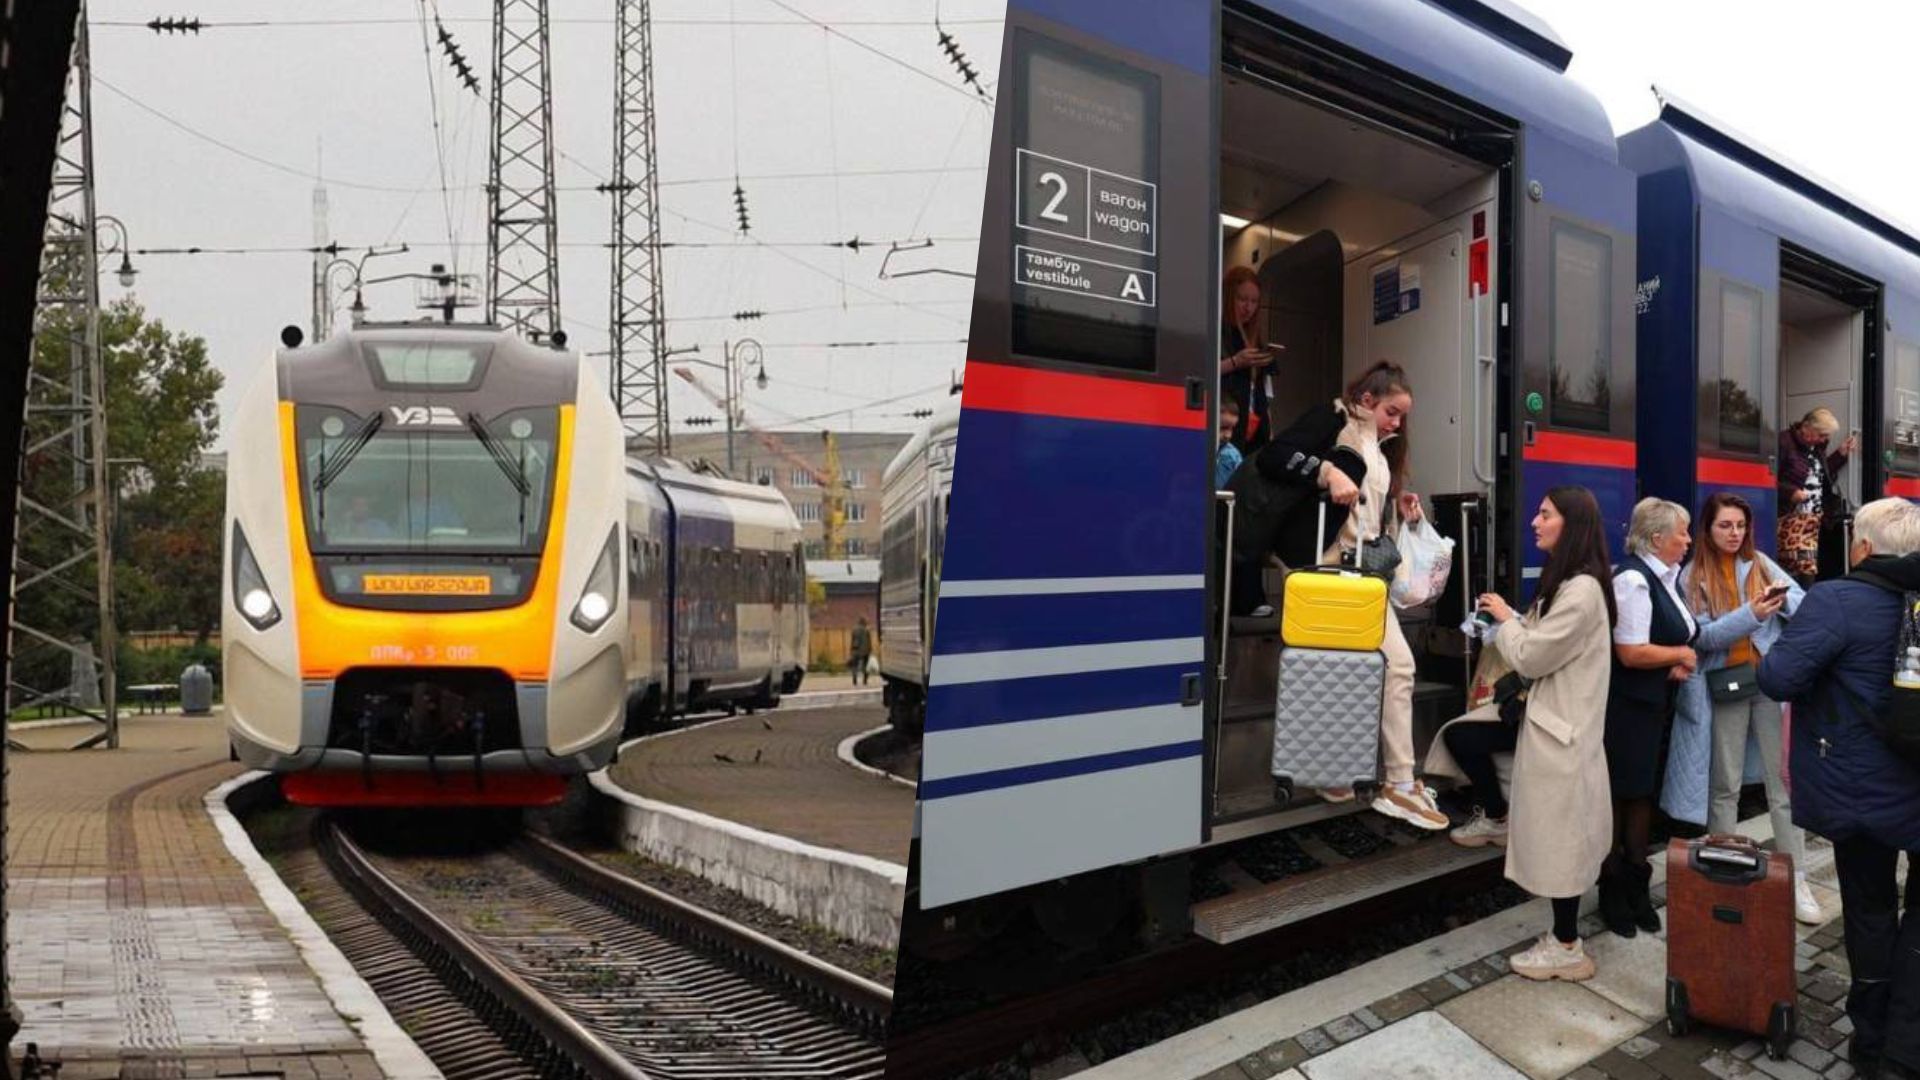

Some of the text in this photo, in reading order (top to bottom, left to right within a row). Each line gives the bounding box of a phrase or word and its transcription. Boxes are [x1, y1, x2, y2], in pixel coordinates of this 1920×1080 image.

[1040, 172, 1068, 223] 2
[1100, 190, 1147, 212] вагон
[1095, 211, 1149, 235] wagon
[1026, 254, 1081, 275] тамбур
[1026, 268, 1091, 289] vestibule
